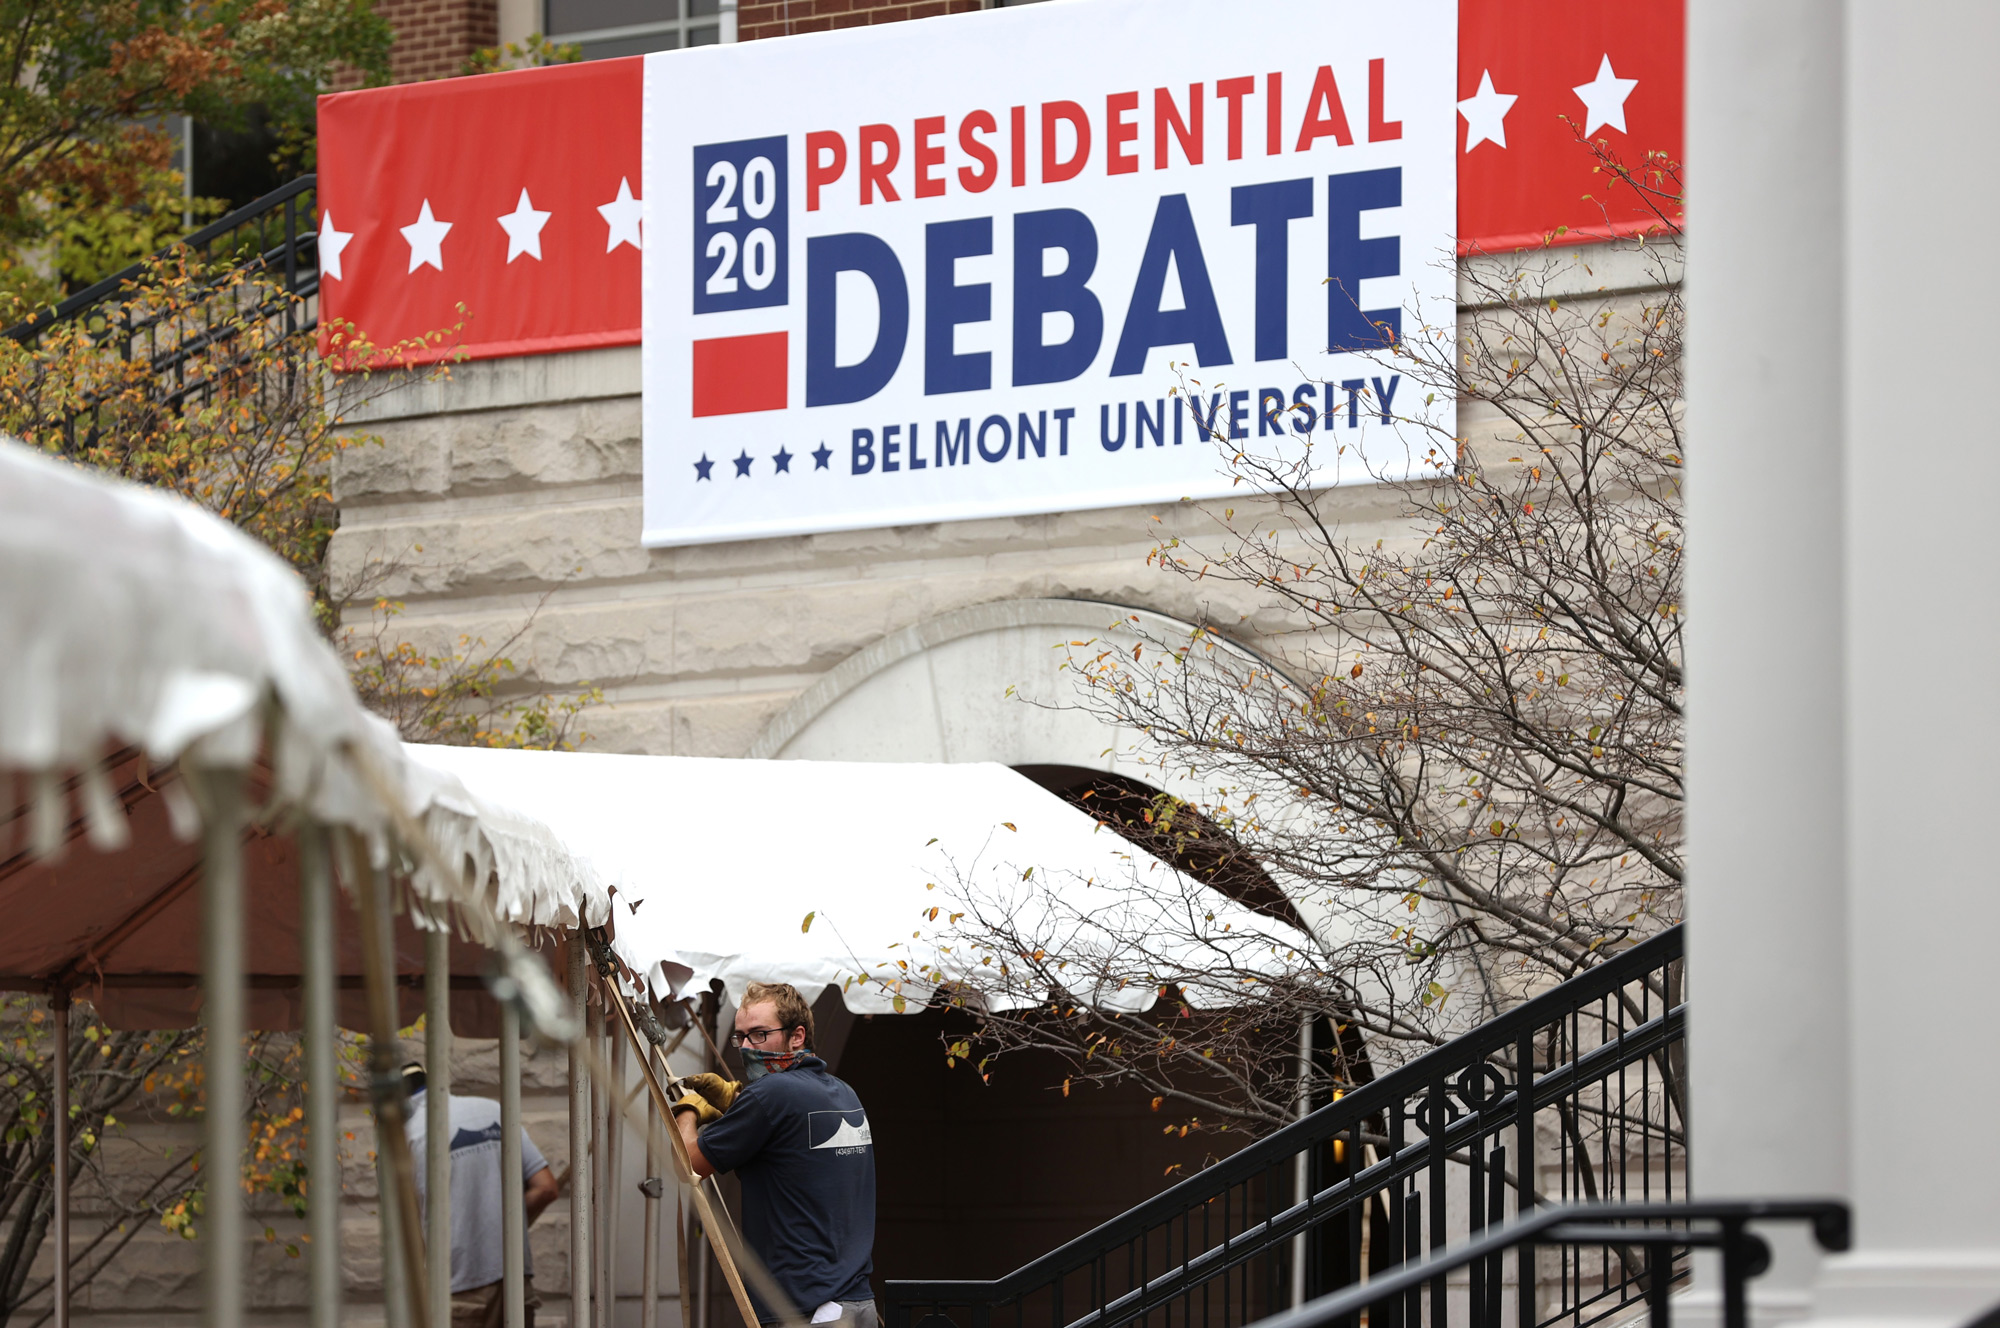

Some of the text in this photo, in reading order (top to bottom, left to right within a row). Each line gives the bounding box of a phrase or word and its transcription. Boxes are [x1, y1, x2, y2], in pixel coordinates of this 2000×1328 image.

[805, 57, 1403, 212] PRESIDENTIAL
[705, 156, 776, 224] 20
[705, 227, 776, 295] 20
[805, 167, 1403, 409] DEBATE
[851, 374, 1401, 476] BELMONT UNIVERSITY
